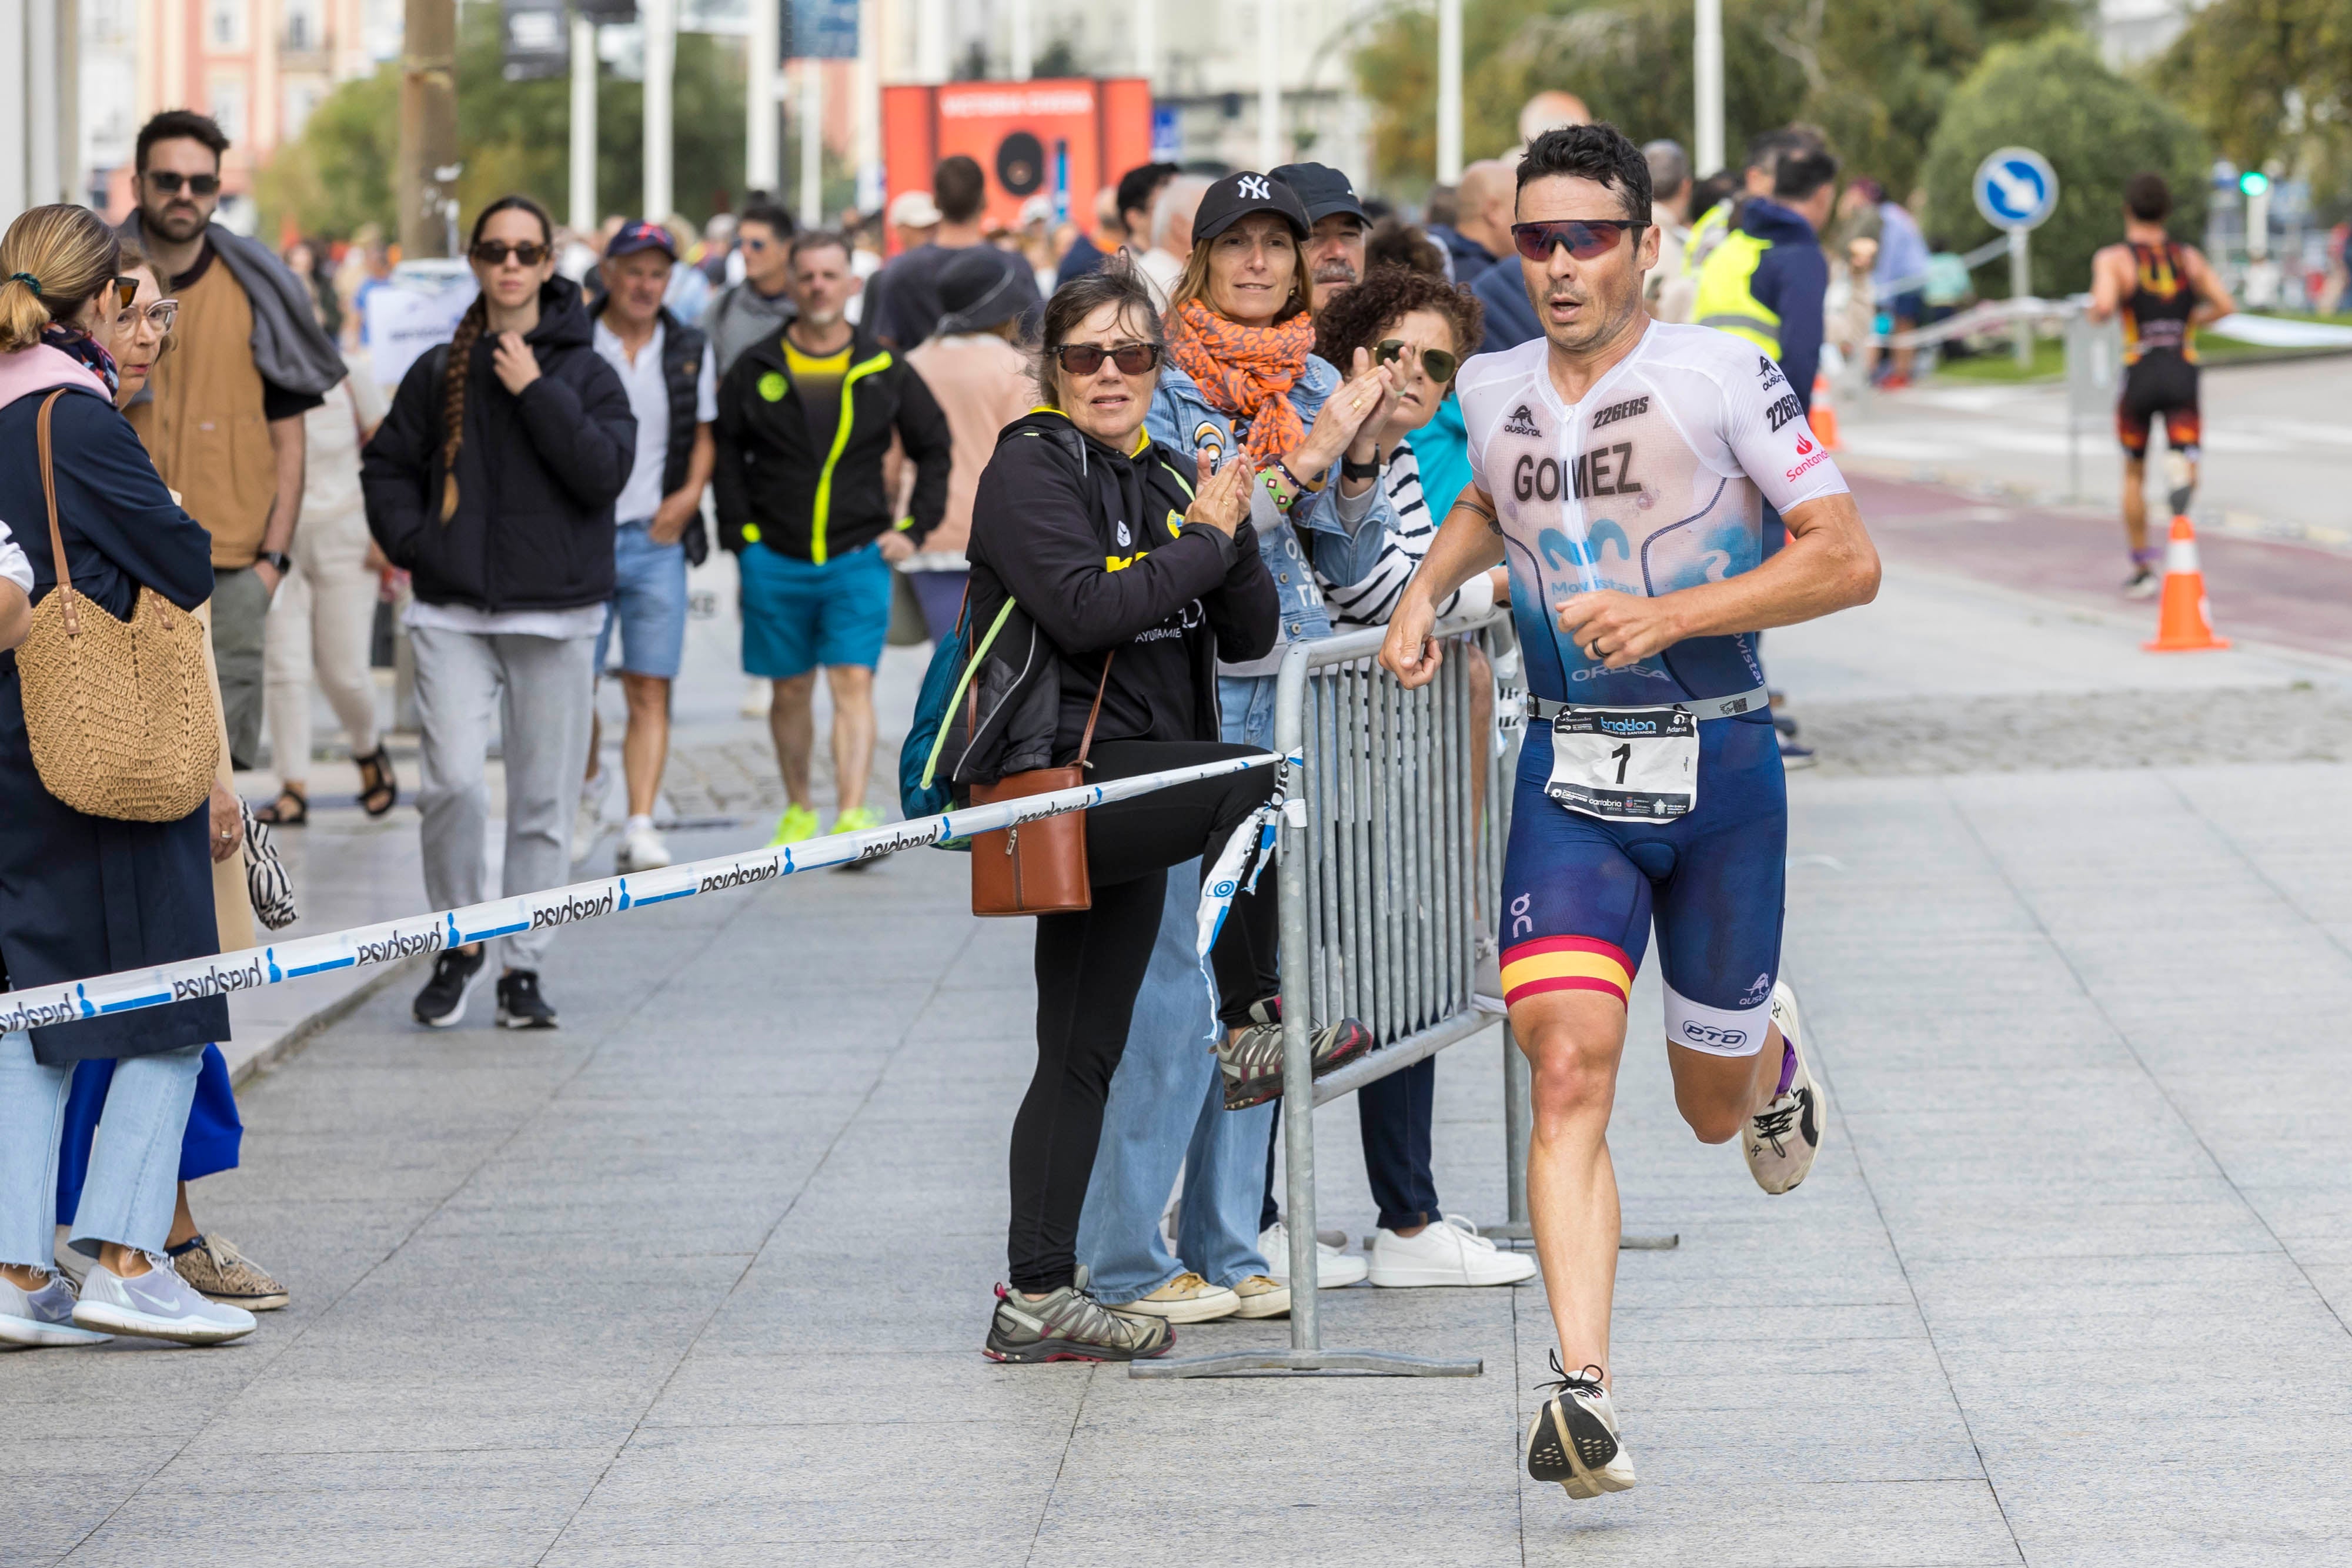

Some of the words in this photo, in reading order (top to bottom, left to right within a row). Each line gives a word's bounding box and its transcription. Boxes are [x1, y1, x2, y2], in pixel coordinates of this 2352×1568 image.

[1237, 175, 1271, 200] NY
[1763, 376, 1785, 391] austra
[1592, 396, 1649, 430] 226ERS
[1766, 393, 1803, 433] 226ER
[1504, 424, 1542, 438] austral
[1514, 442, 1642, 502] GOMEZ
[1551, 579, 1639, 596] Movistar
[1733, 633, 1764, 686] ovistar
[1601, 717, 1656, 731] triatlon
[1611, 743, 1631, 784] 1
[1588, 798, 1622, 807] cantabria
[1686, 1024, 1742, 1044] PTO
